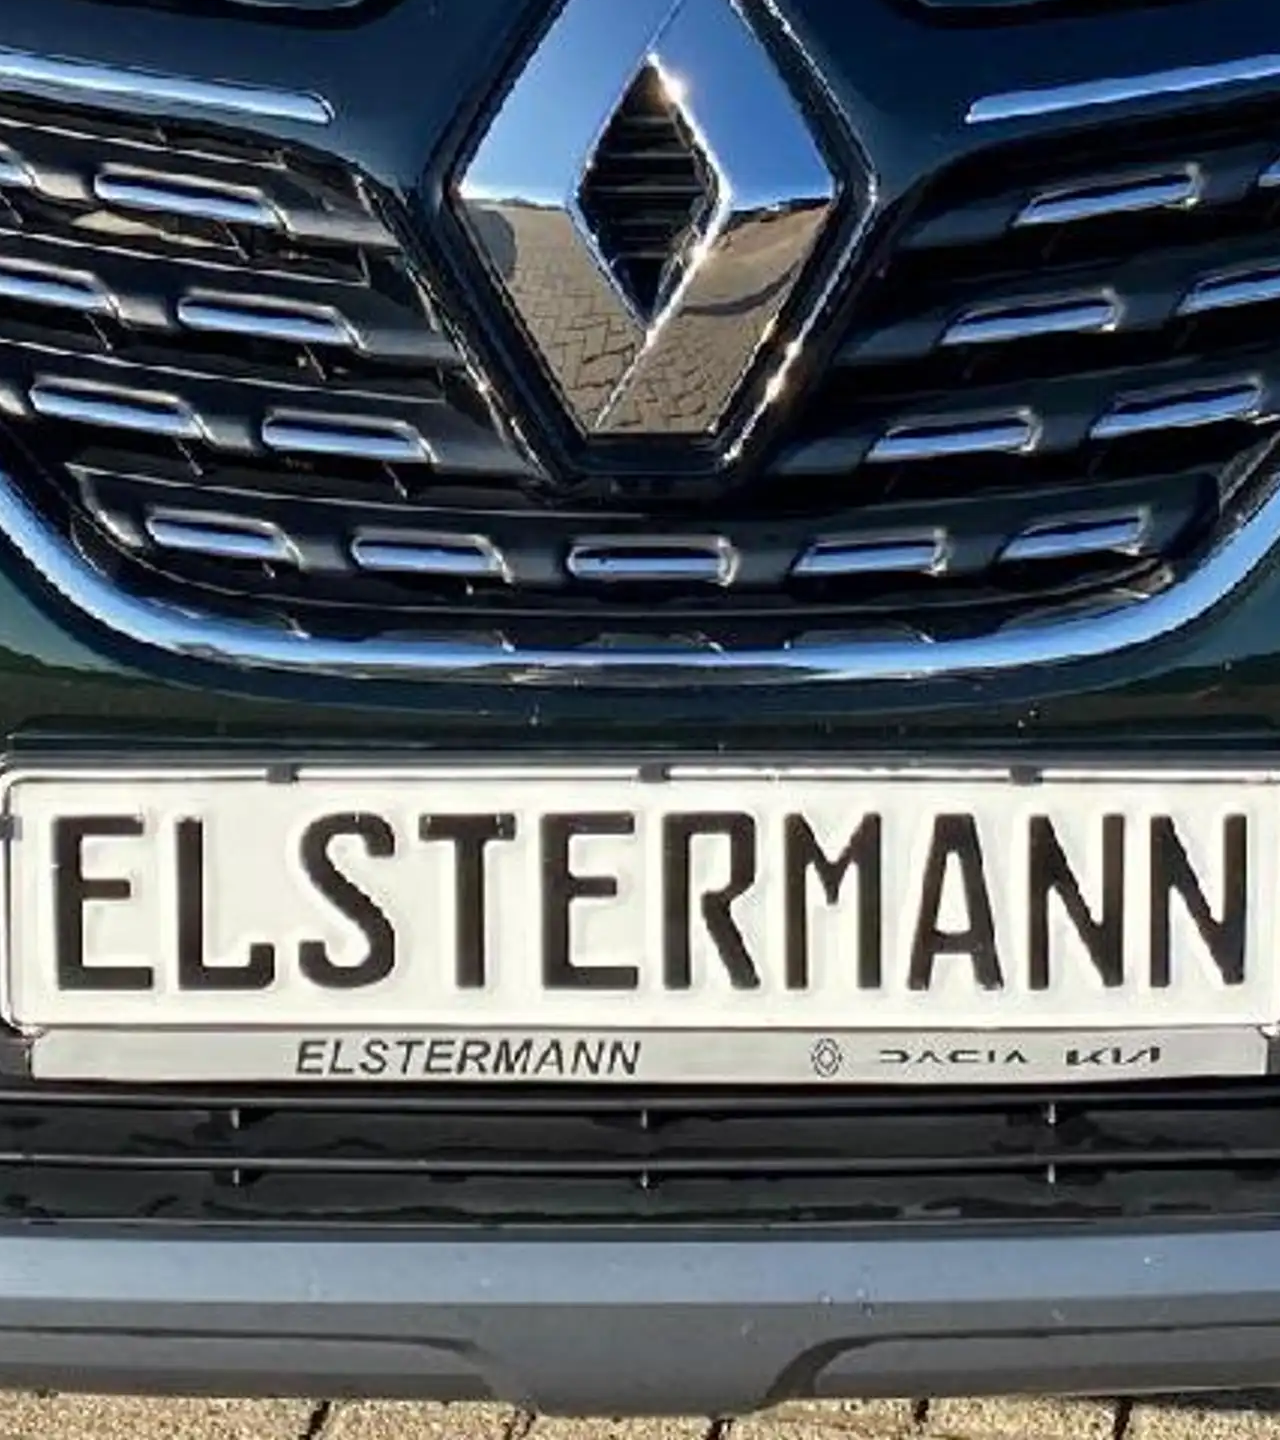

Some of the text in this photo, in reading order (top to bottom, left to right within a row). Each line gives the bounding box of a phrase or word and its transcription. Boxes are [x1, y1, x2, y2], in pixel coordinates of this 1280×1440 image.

[54, 813, 1247, 990] ELSTERMANN
[296, 1039, 641, 1075] ELSTERMANN
[879, 1046, 1161, 1066] DACIA KIA
